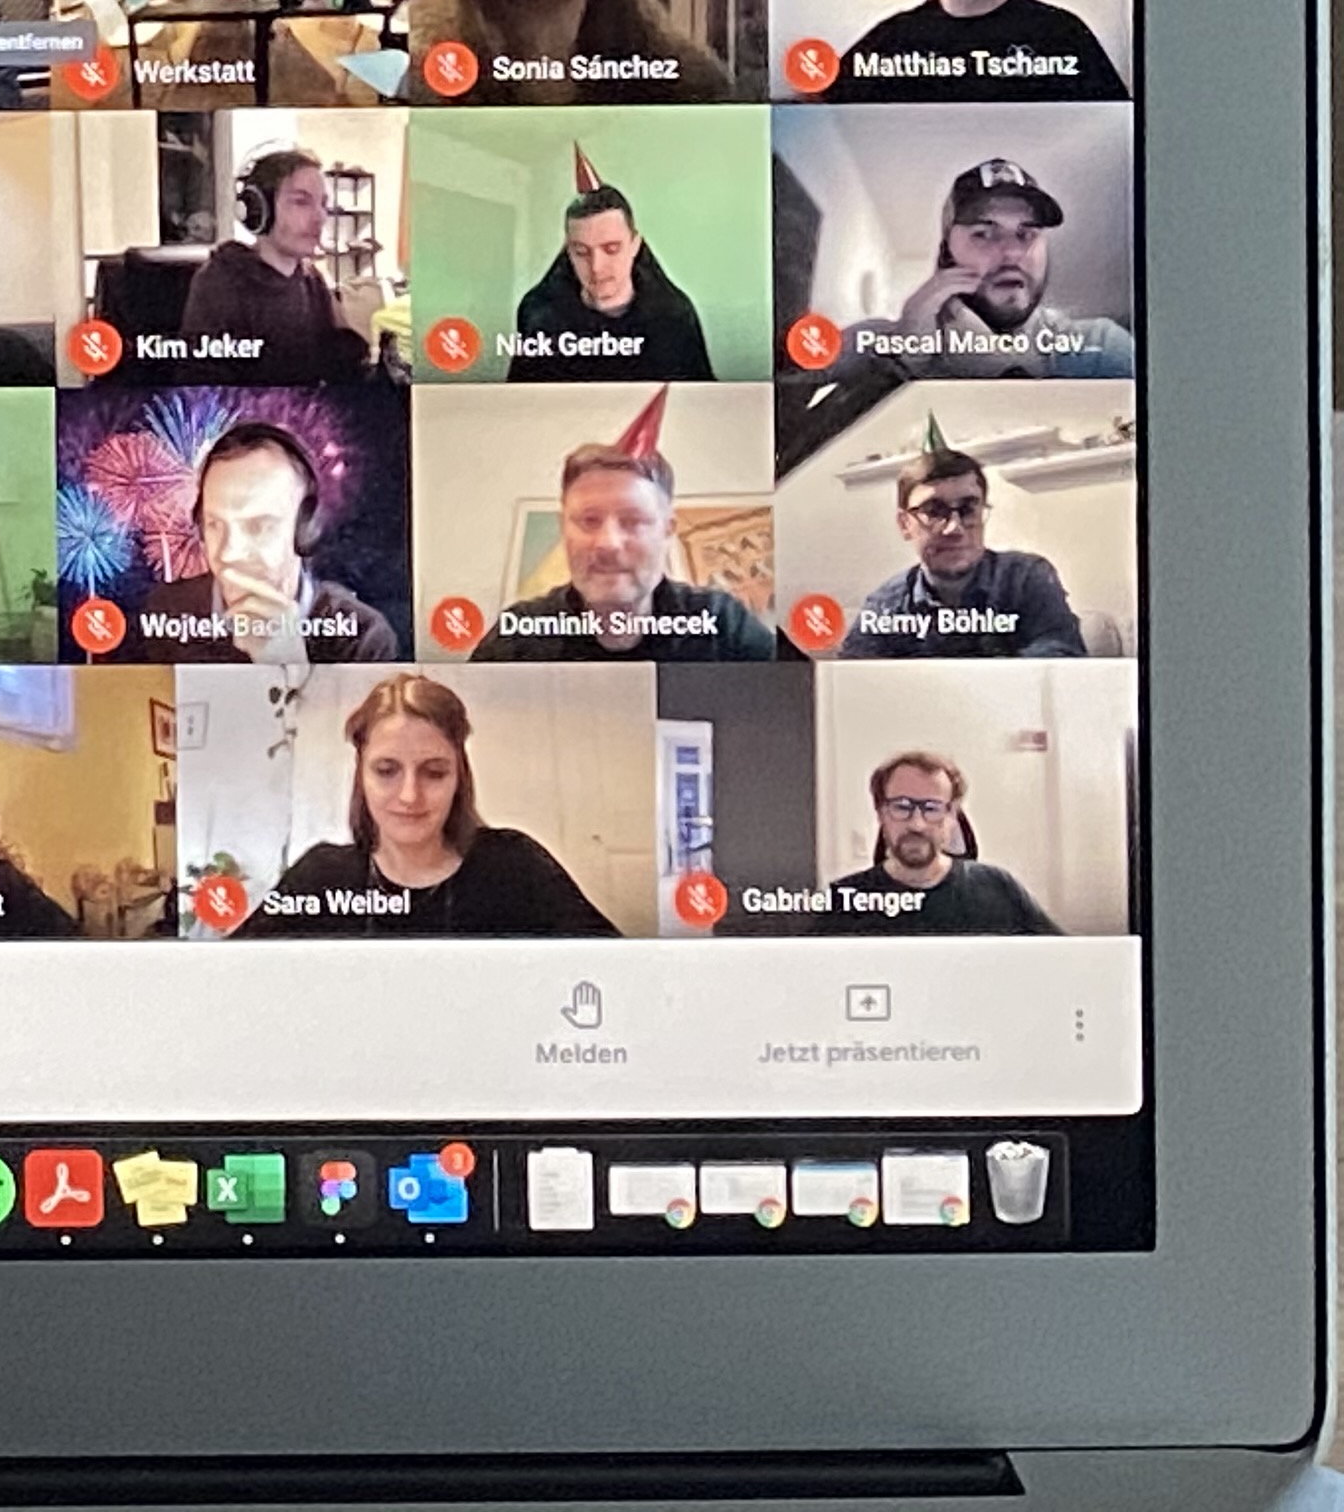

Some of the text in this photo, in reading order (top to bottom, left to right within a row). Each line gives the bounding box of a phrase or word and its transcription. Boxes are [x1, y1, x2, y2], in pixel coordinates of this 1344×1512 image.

[133, 58, 256, 85] Werkstatt
[492, 53, 680, 82] Sonia Sánchez
[853, 51, 1080, 78] Matthias Tschanz
[136, 333, 265, 359] Kim Jeker
[496, 330, 645, 358] Nick Gerber
[855, 329, 943, 355] Pascal
[949, 328, 1030, 354] Marco
[140, 613, 228, 644] Wojtek
[499, 609, 719, 637] Dominik Simecek
[860, 607, 1020, 641] Rémy Böhler
[263, 889, 410, 915] Sara Weibel
[742, 887, 925, 917] Gabriel Tenger
[536, 1044, 628, 1066] Melden
[758, 1041, 980, 1067] Jetzt präsentieren
